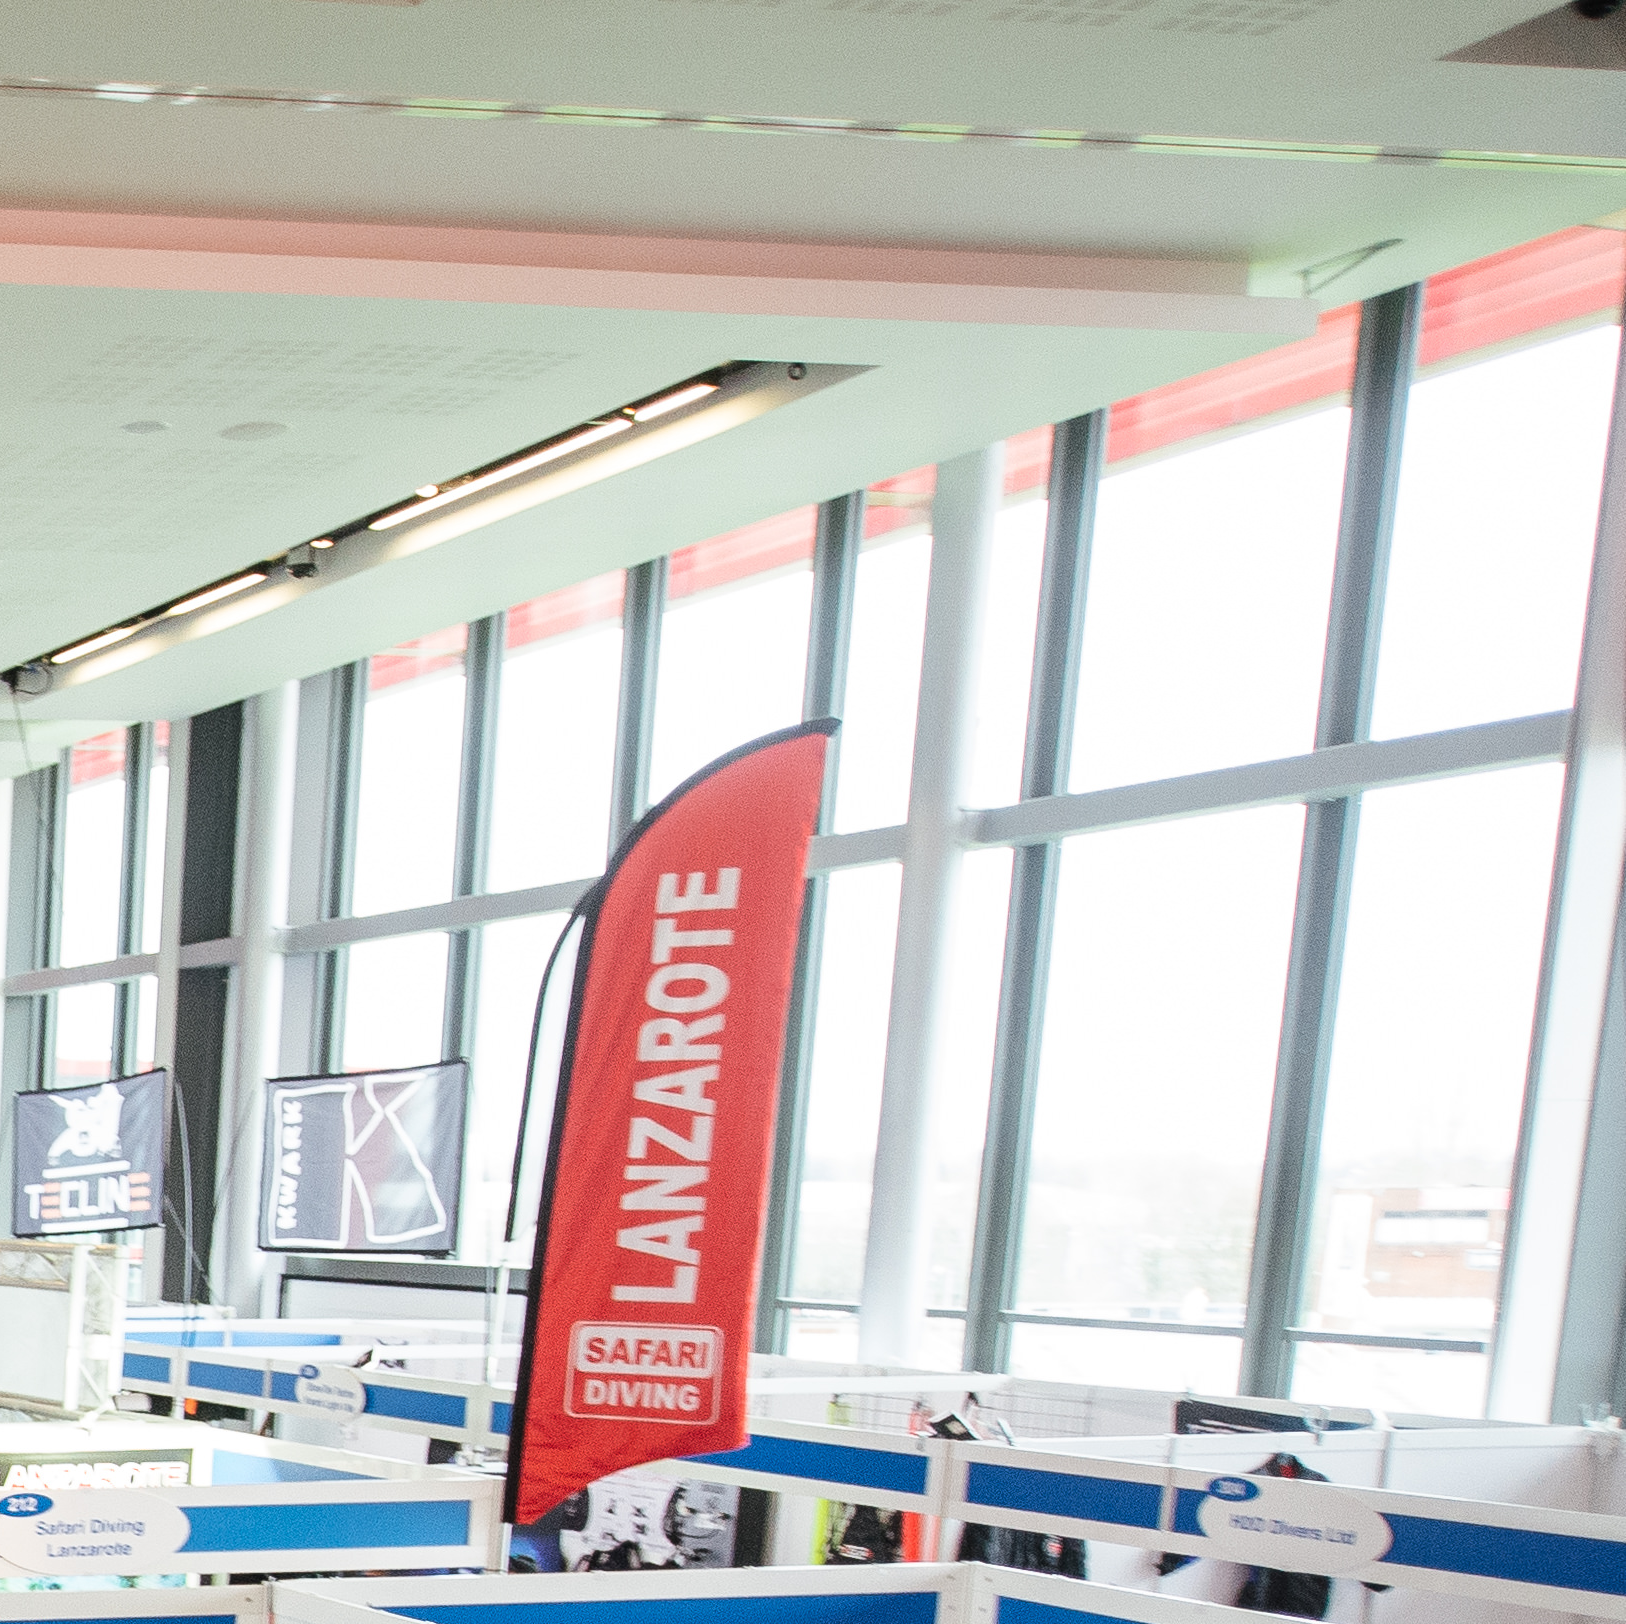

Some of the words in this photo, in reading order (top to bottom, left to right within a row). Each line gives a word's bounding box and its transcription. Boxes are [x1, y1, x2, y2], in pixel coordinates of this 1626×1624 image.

[610, 866, 742, 1305] LANZAROTE
[276, 1100, 304, 1231] KWARK
[24, 1172, 151, 1220] TECLINE
[585, 1336, 710, 1370] SAFARI
[582, 1378, 700, 1413] DIVING
[6, 1496, 39, 1513] 212
[35, 1518, 86, 1538] Safari
[89, 1516, 145, 1538] Diving
[1269, 1518, 1323, 1541] Divers
[47, 1541, 133, 1559] Lanzarote
